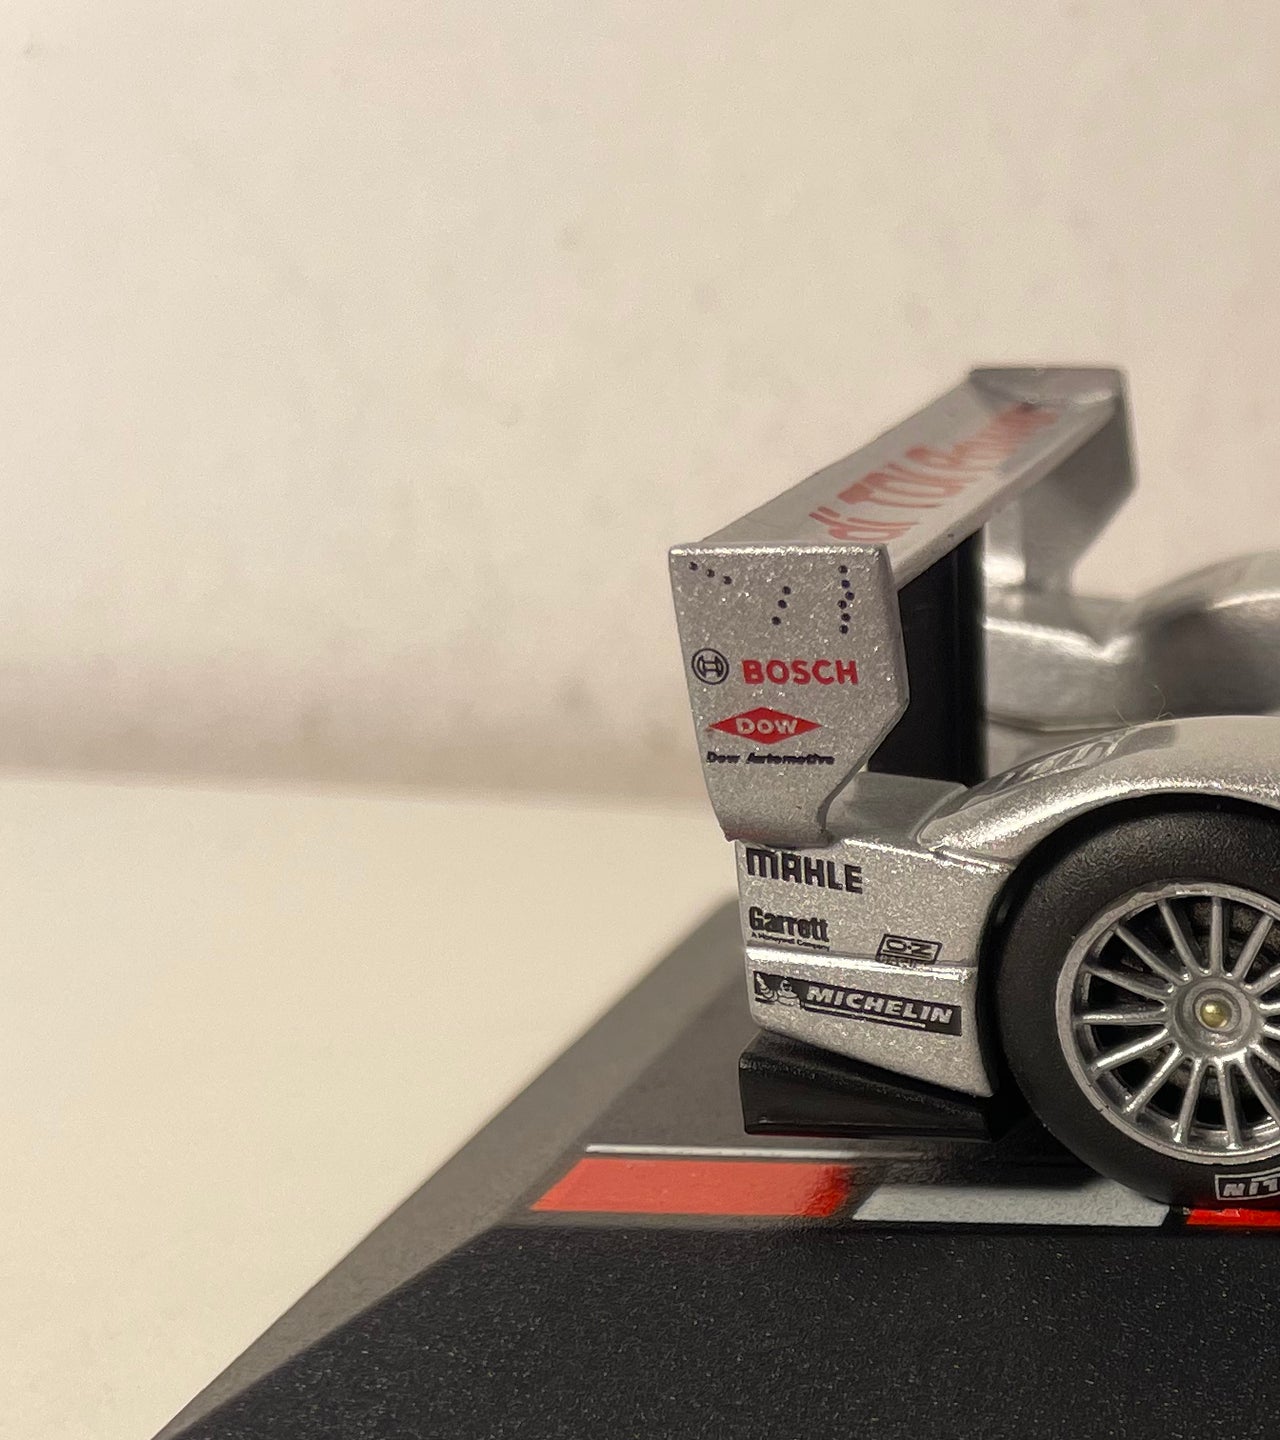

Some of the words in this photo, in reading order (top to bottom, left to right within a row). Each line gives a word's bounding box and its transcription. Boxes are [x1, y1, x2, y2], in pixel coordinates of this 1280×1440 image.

[741, 659, 859, 686] BOSCH
[706, 750, 741, 764] Dow
[746, 849, 863, 894] MAHLE
[749, 906, 830, 943] Garrett
[806, 985, 954, 1024] MICHELIN
